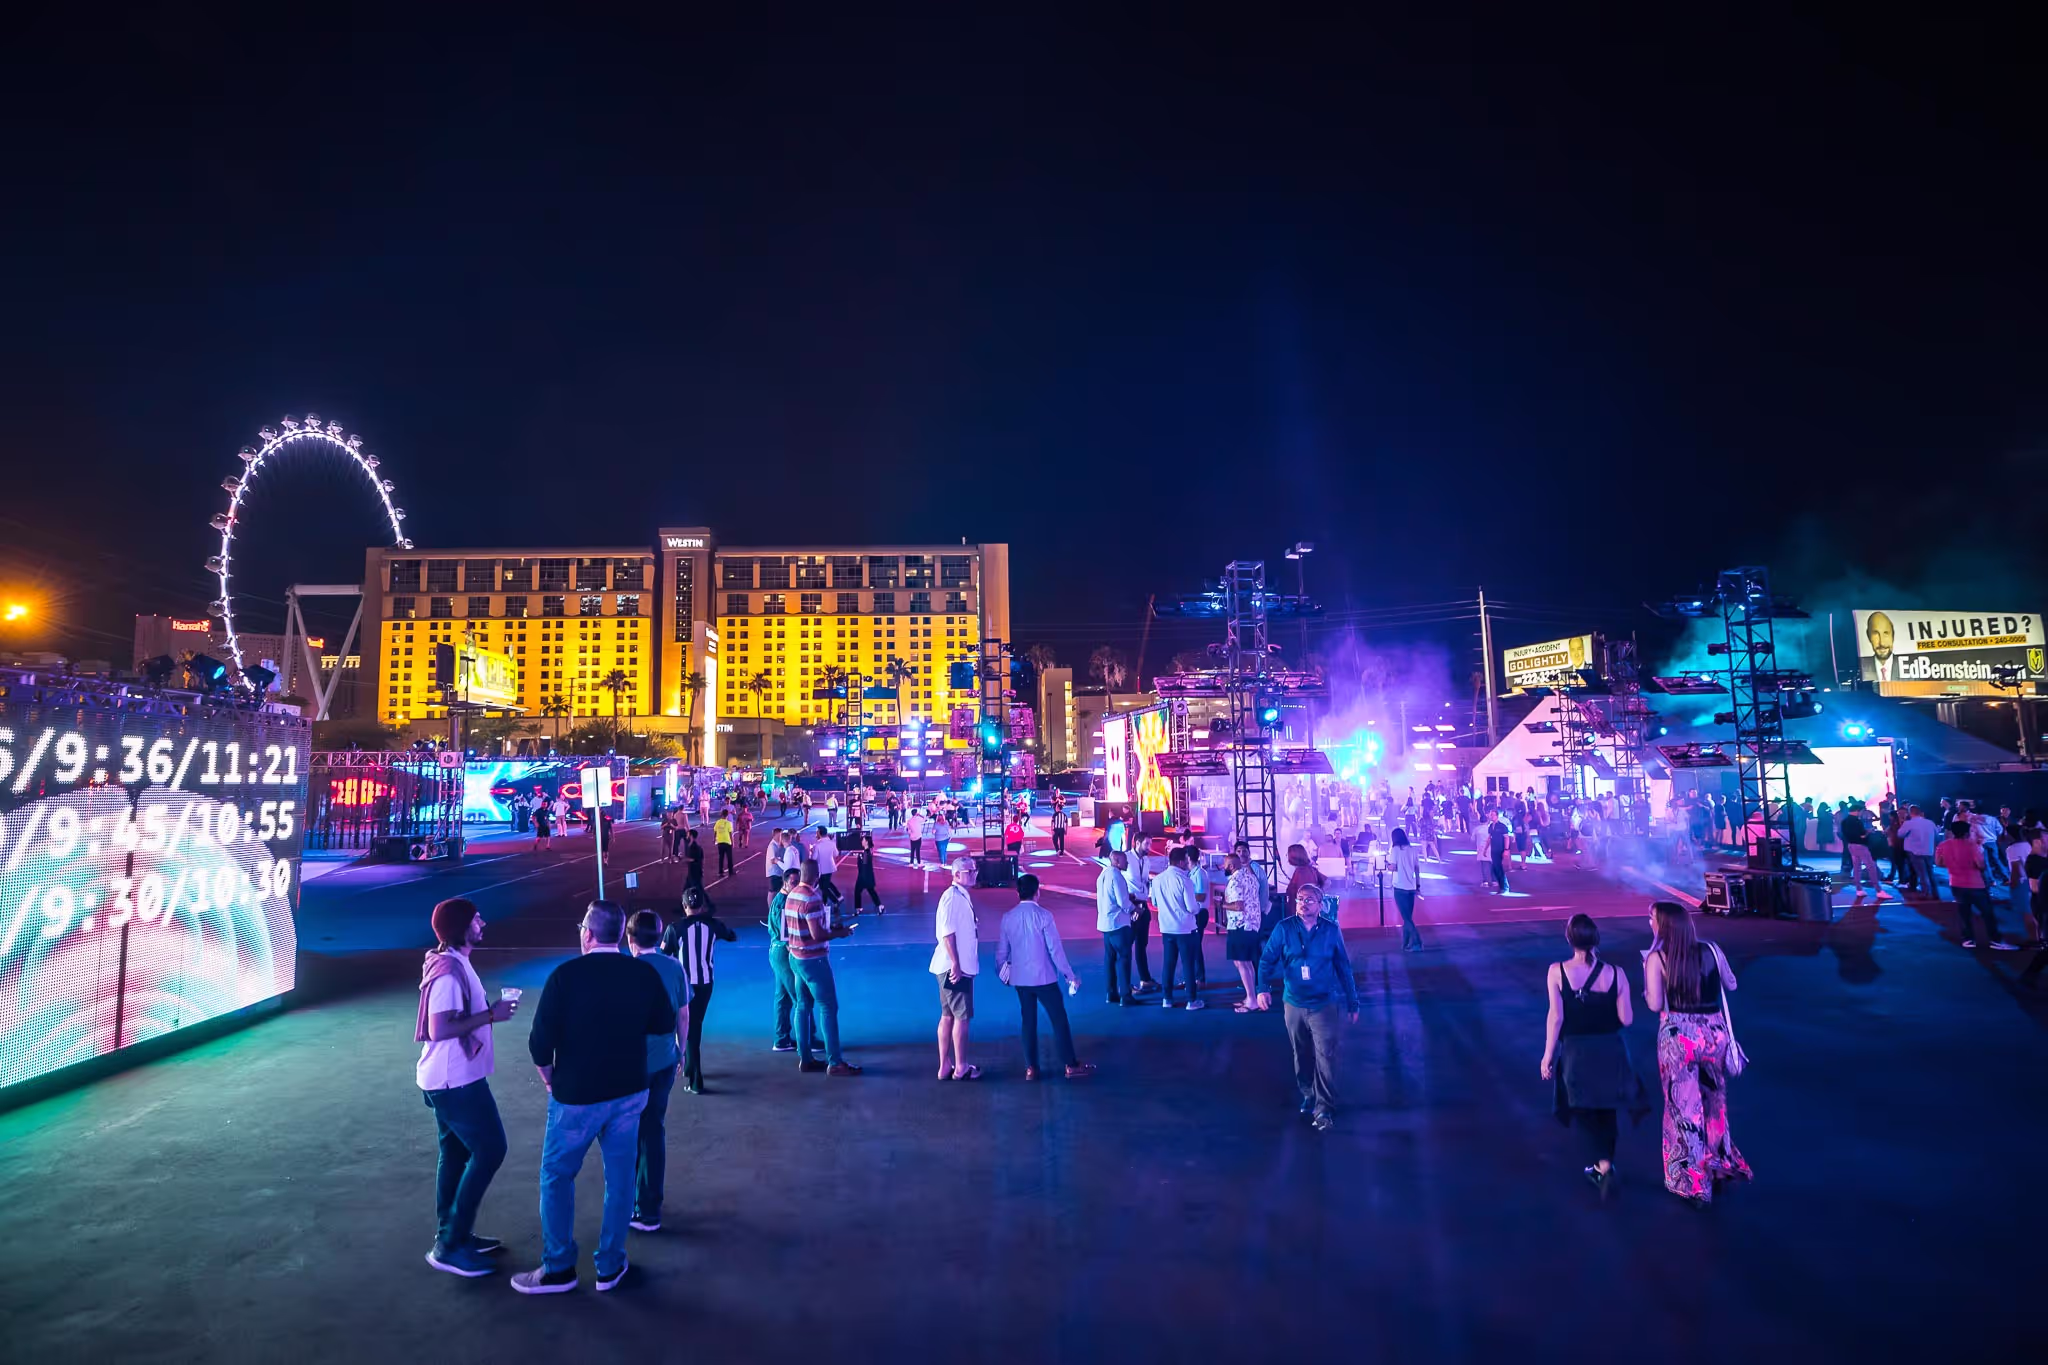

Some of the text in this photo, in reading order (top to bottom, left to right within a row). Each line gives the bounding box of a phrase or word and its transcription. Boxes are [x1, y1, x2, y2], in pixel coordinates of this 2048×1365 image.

[1907, 615, 2032, 641] INJURED?
[1534, 643, 1561, 653] ACCIDENT
[1917, 640, 1936, 650] FREE
[1937, 637, 1988, 648] CONSULTATION
[1509, 653, 1568, 671] GOLIGHTLY
